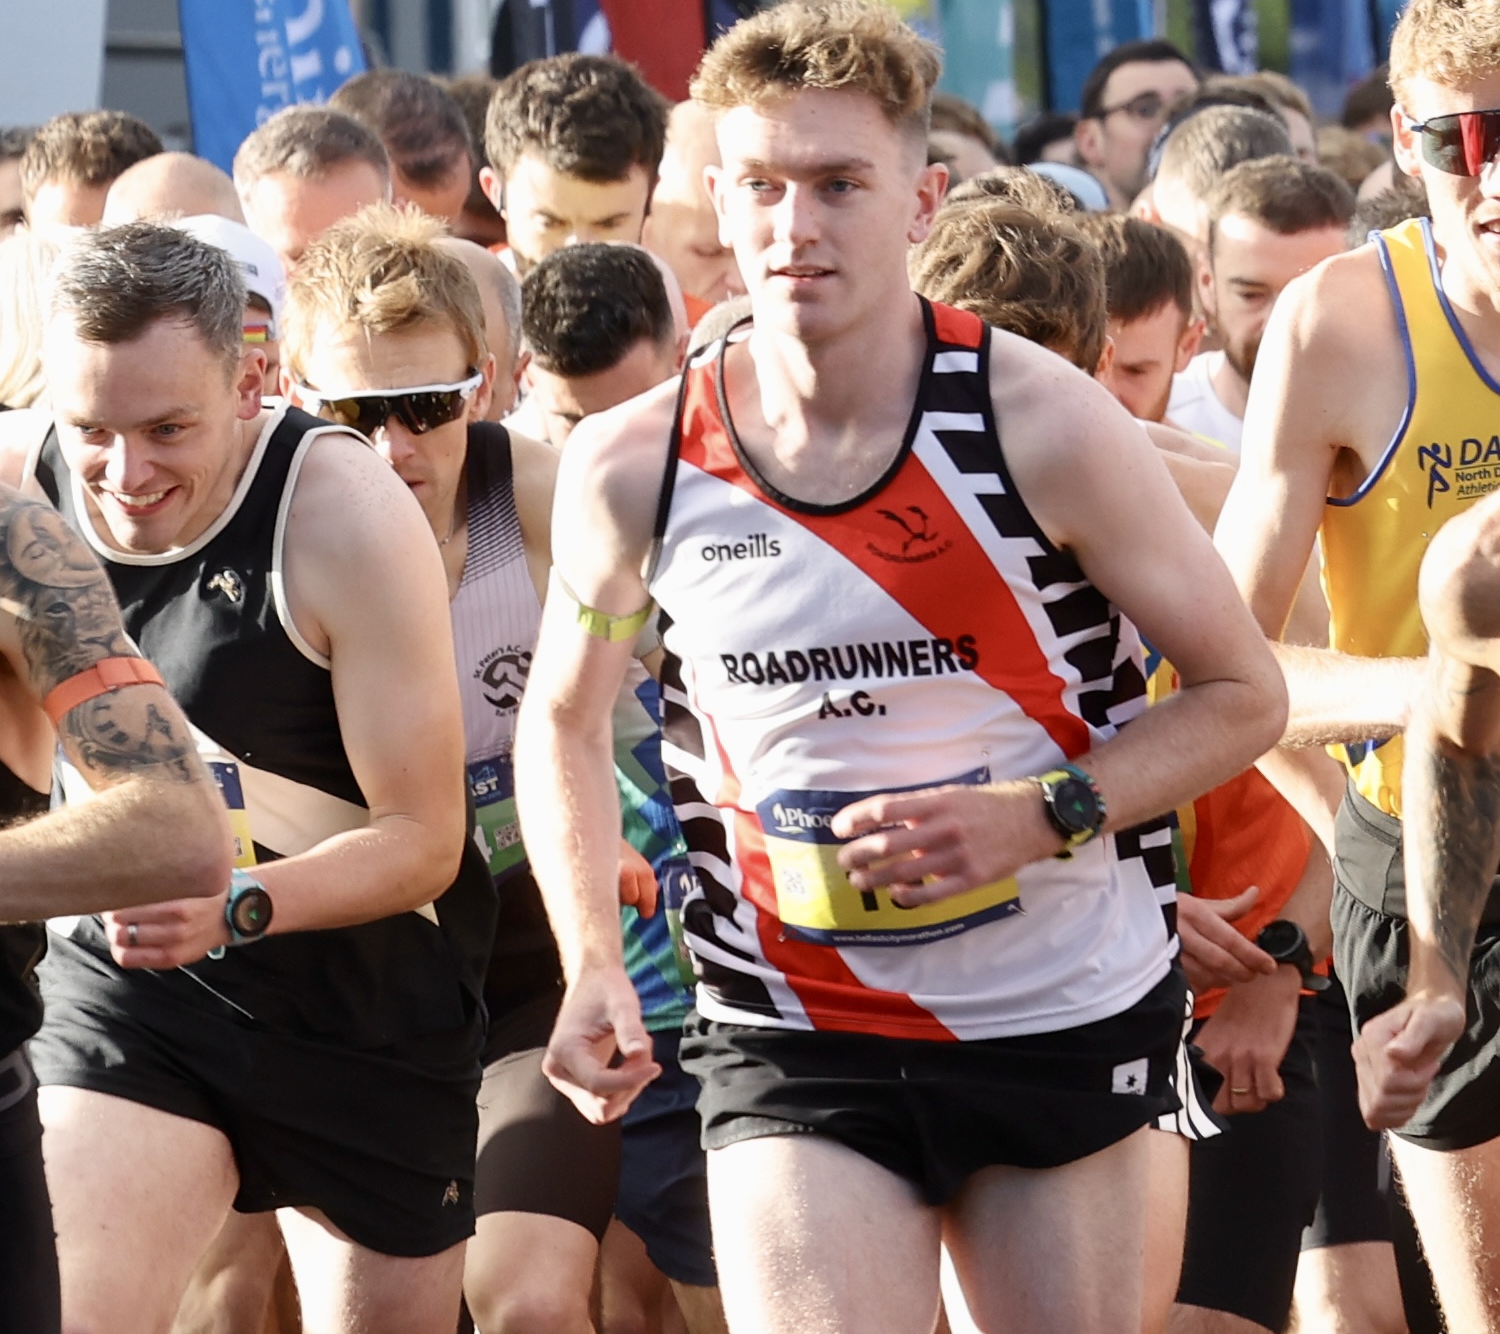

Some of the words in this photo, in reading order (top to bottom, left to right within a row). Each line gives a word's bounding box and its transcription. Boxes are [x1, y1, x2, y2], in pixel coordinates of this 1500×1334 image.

[1455, 468, 1491, 483] North
[720, 634, 980, 686] ROADRUNNERS
[818, 690, 887, 719] A.C.
[787, 806, 832, 829] Phoe
